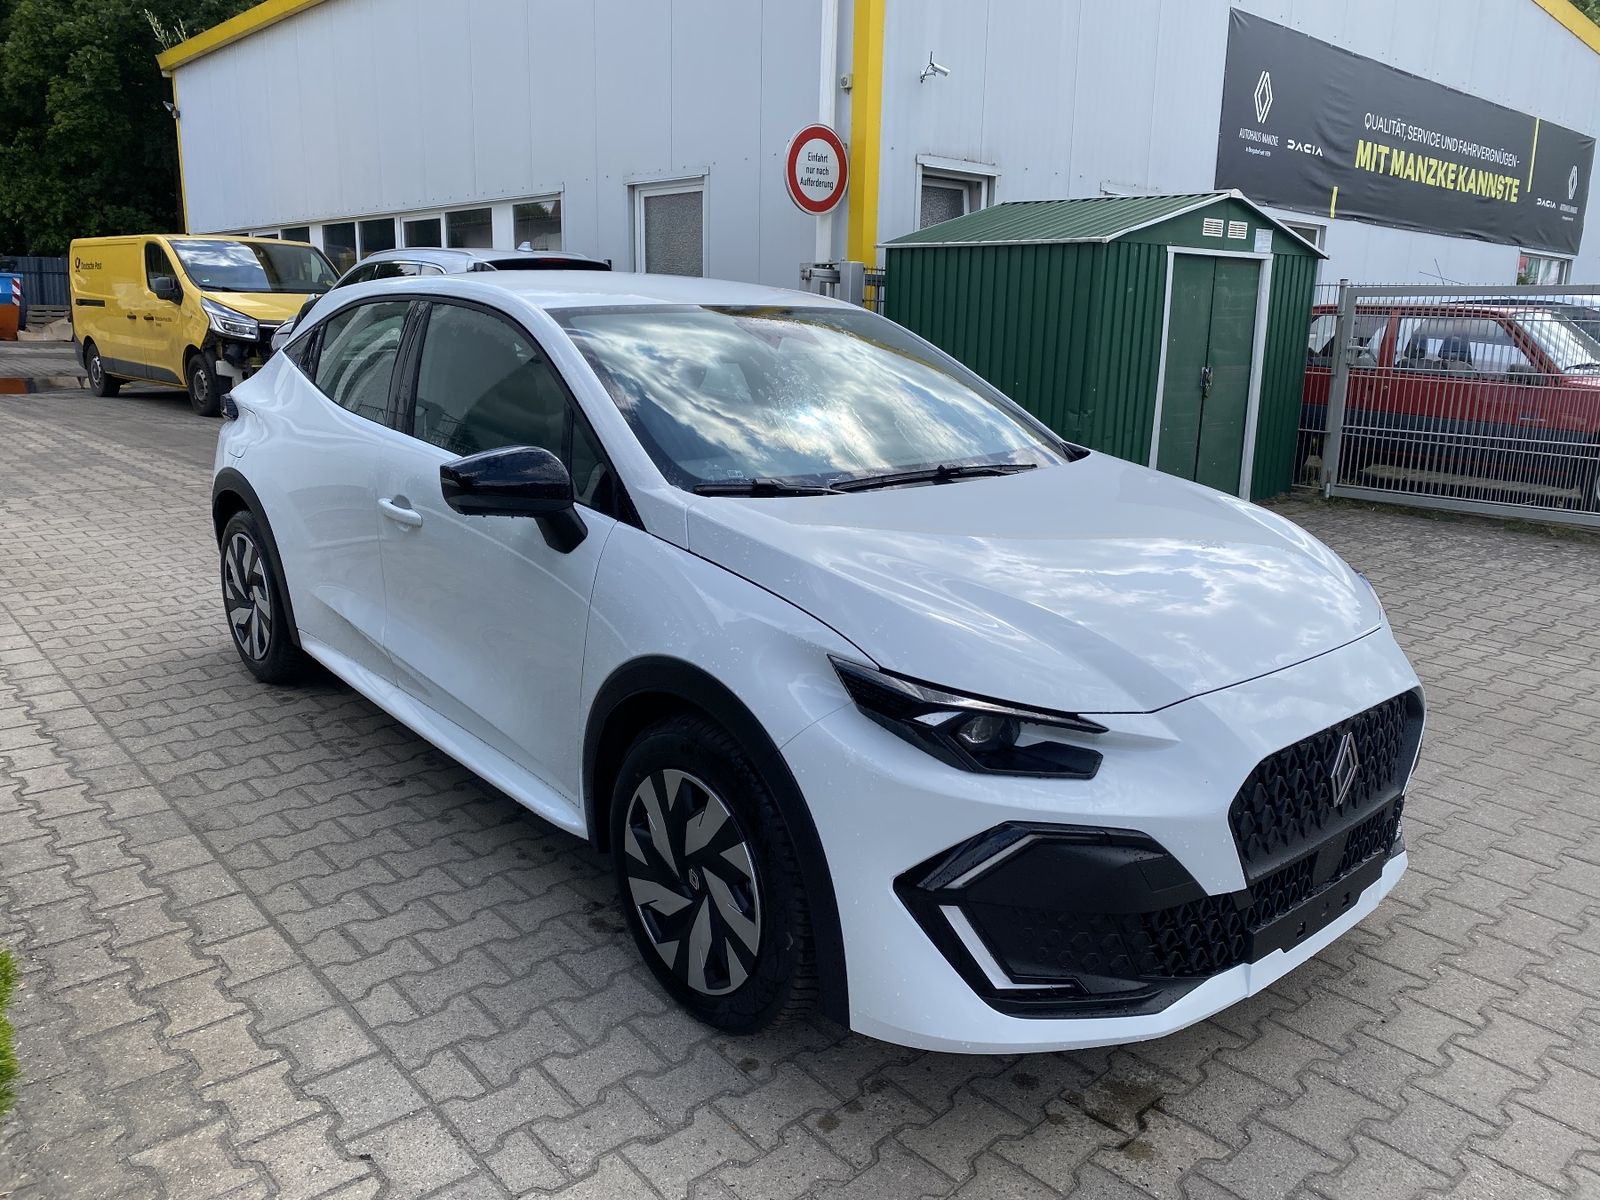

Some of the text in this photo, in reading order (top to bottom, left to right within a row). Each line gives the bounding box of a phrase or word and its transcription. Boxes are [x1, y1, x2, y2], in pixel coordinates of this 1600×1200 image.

[1365, 112, 1406, 140] QUALITÄT,
[1407, 124, 1441, 147] SERVICE
[1440, 134, 1459, 152] UND
[1286, 139, 1323, 157] DACIA
[808, 152, 828, 163] Einfahrt
[806, 166, 829, 175] nur nach
[1354, 139, 1521, 203] MIT MANZKE KANNSTE
[800, 177, 833, 190] Aufforderung
[1536, 198, 1556, 208] DACIA
